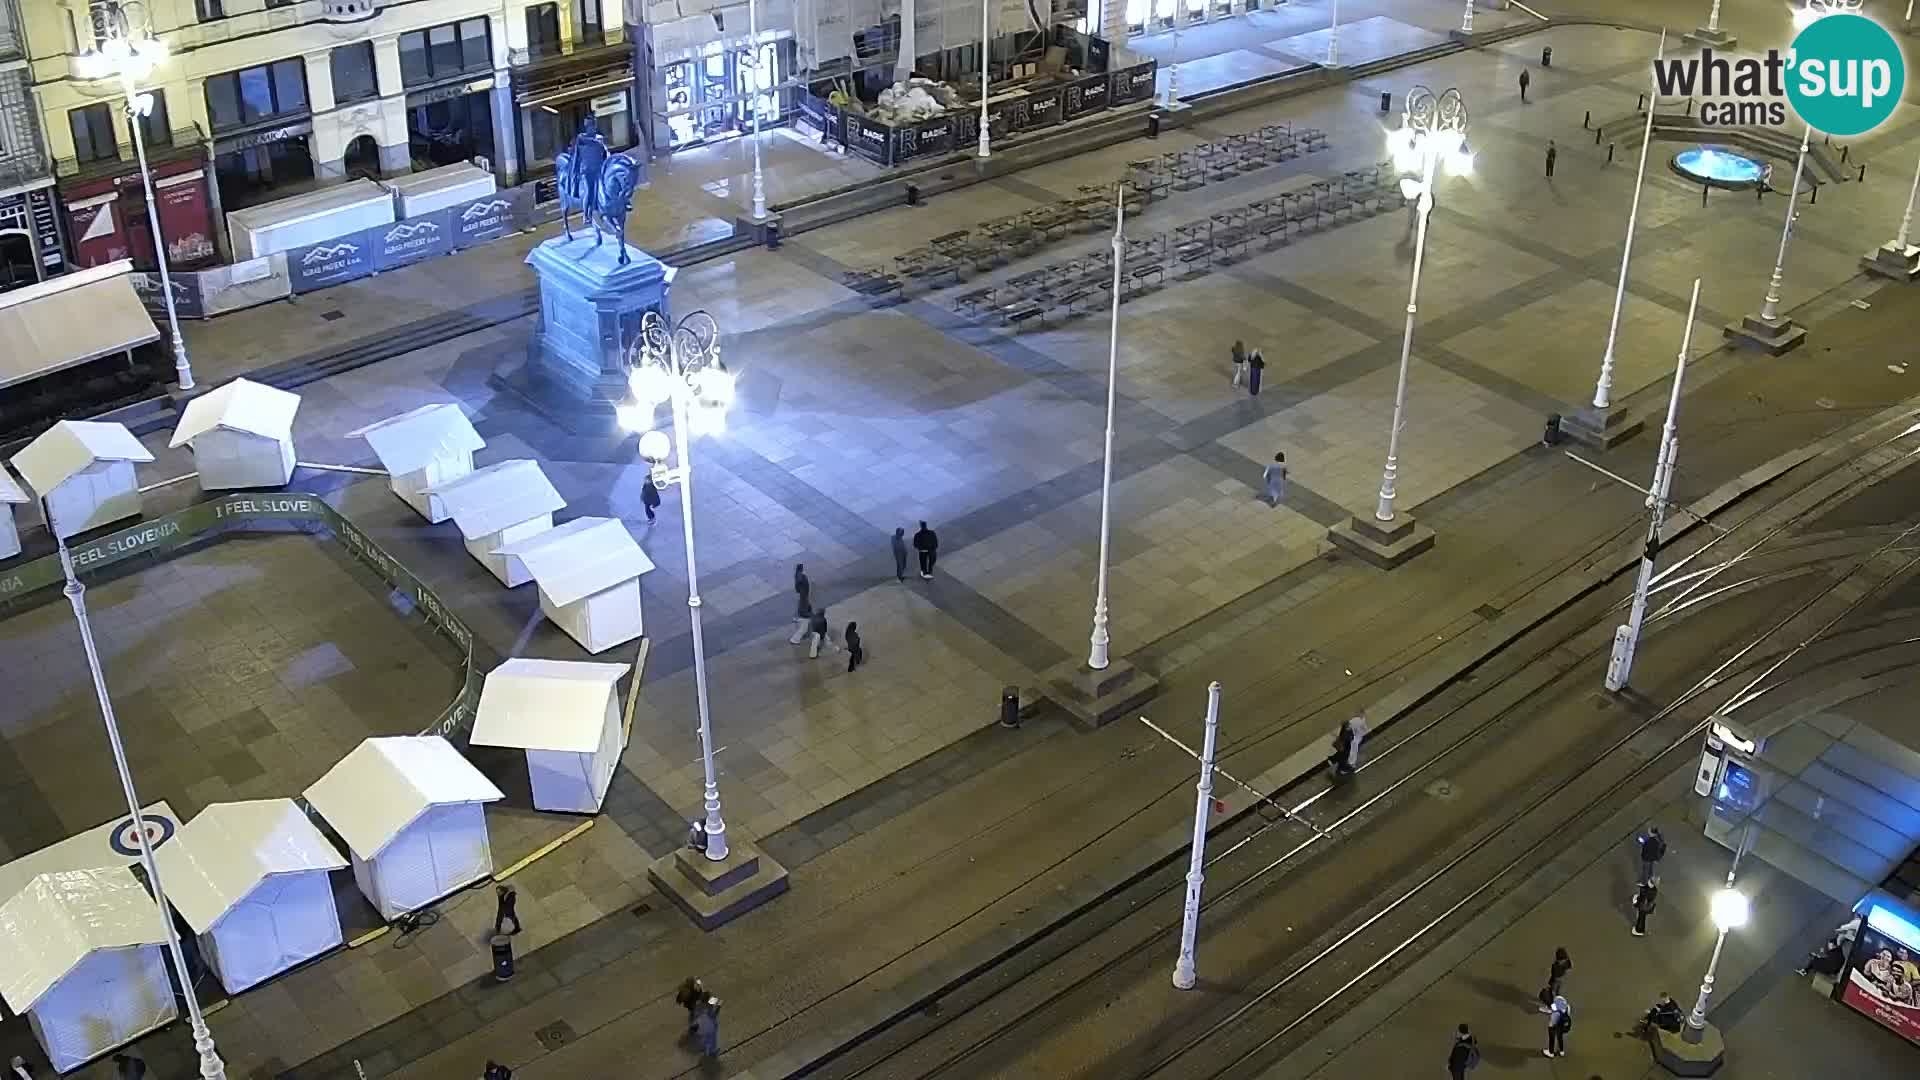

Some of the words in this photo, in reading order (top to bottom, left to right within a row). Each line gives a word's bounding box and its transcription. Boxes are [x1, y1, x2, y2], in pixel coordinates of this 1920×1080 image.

[216, 506, 223, 518] I
[225, 500, 260, 516] FEEL
[71, 546, 107, 568] FEEL
[107, 520, 181, 555] SLOVENIA
